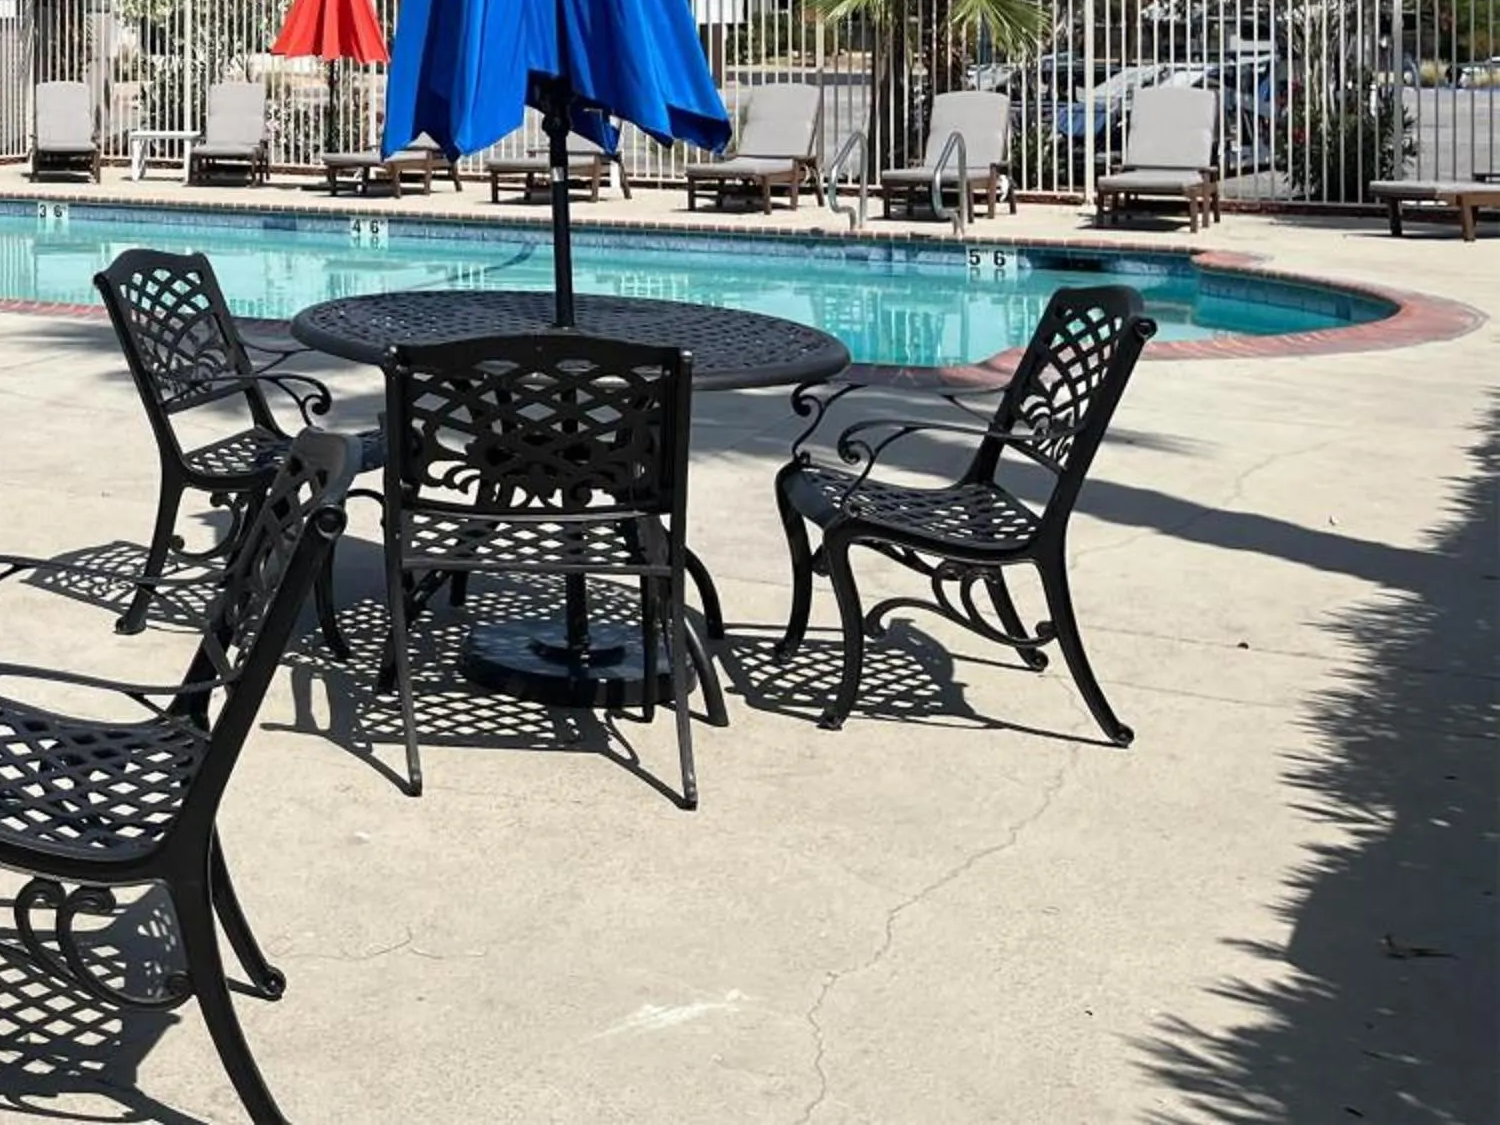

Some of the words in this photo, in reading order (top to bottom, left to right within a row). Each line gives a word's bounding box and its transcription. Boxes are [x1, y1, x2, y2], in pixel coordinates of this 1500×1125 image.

[39, 204, 47, 218] 3
[53, 204, 63, 218] 6
[351, 218, 361, 233] 4
[370, 218, 380, 234] 6
[969, 248, 981, 266] 5
[993, 250, 1006, 267] 6
